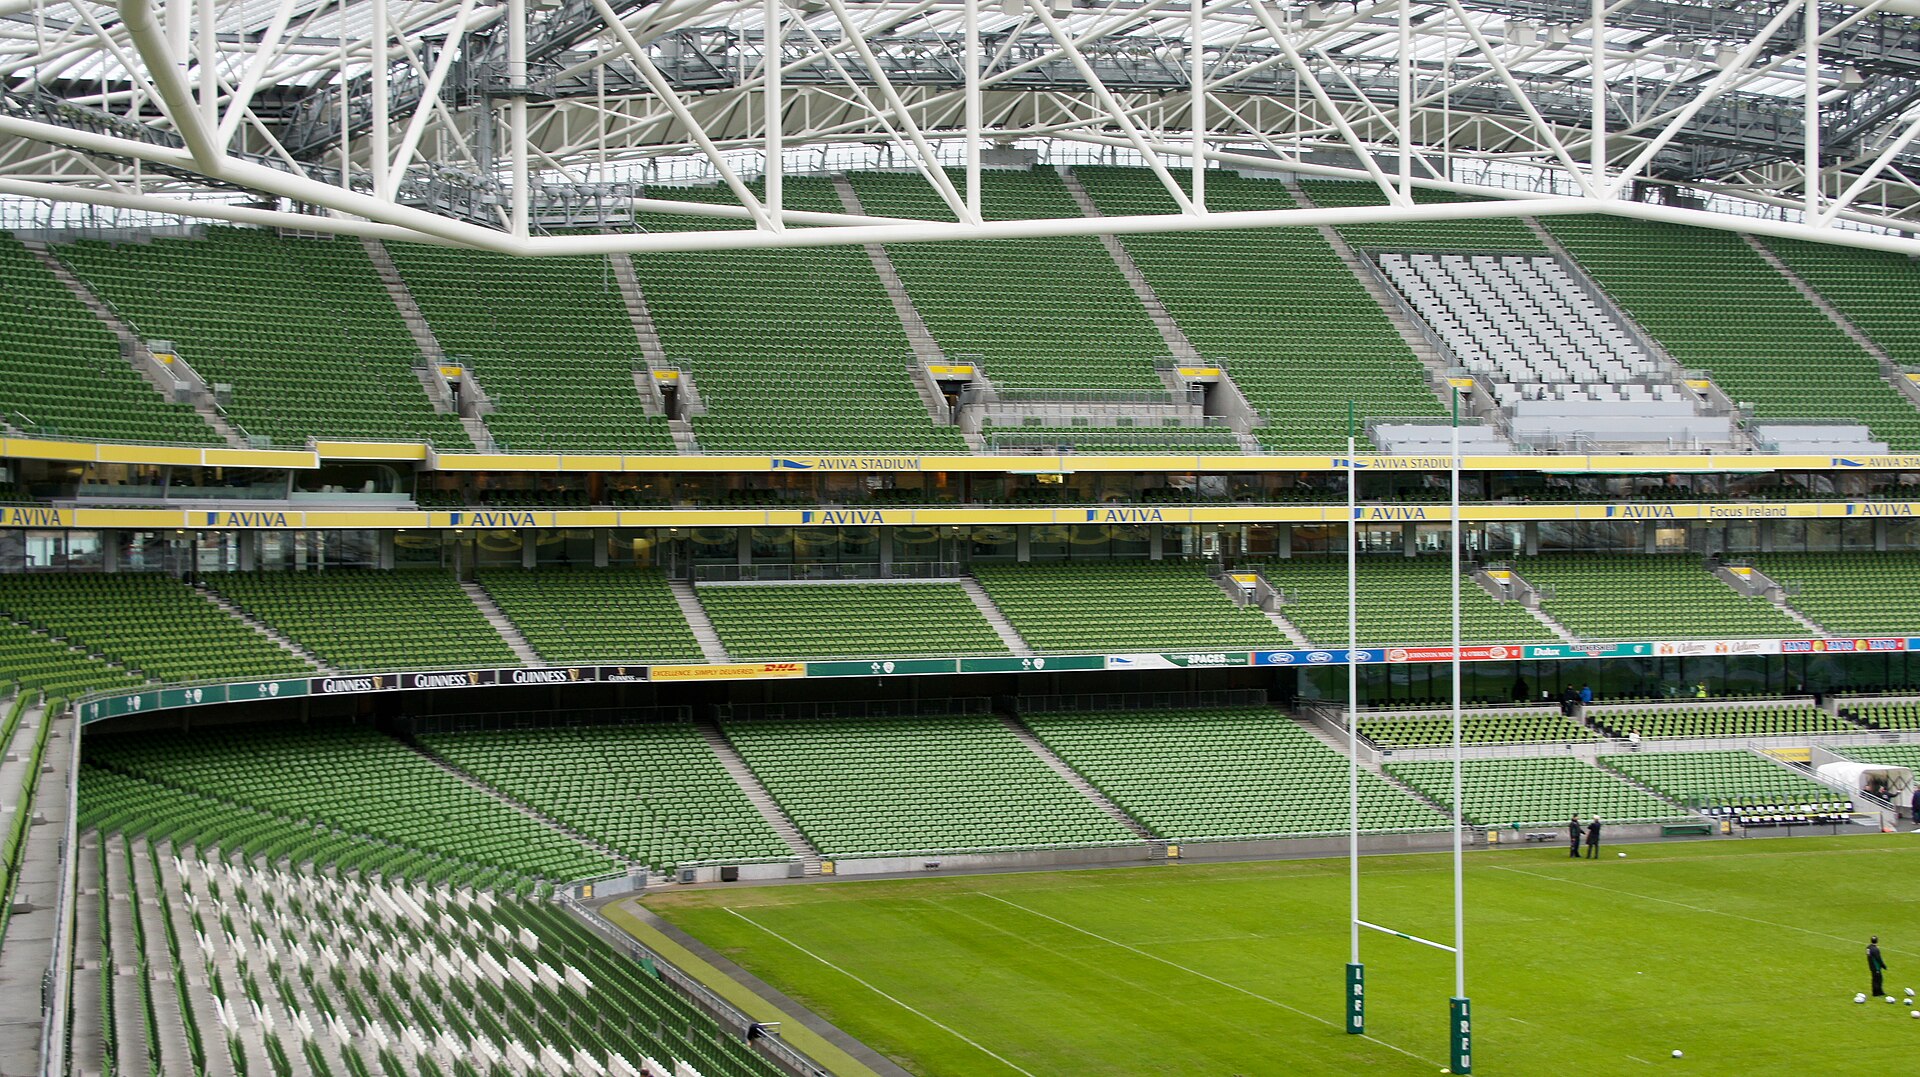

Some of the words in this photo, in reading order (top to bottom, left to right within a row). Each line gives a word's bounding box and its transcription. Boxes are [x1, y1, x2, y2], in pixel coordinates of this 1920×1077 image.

[818, 458, 858, 469] AVIVA
[861, 458, 919, 470] STADIUM
[1372, 458, 1408, 469] AVIVA
[1868, 457, 1901, 468] AVIVA
[1105, 509, 1163, 522] AVIVA
[1371, 507, 1426, 520] AVIVA
[1623, 506, 1674, 518] AVIVA
[1710, 506, 1742, 517] Focus
[1746, 505, 1787, 517] Ireland
[1862, 504, 1912, 515] AVIVA
[11, 509, 61, 526] AVIVA
[227, 512, 287, 527] AVIVA
[471, 512, 536, 526] AVIVA
[822, 511, 884, 524] AVIVA
[1533, 647, 1560, 656] Dulux
[1187, 654, 1226, 663] SPACES
[764, 664, 797, 672] DHL
[414, 674, 467, 688] GUINNESS
[512, 669, 567, 684] GUINNESS
[322, 678, 373, 693] GUINNESS
[1353, 968, 1363, 1028] IRFU
[1460, 1003, 1470, 1068] IRFU
